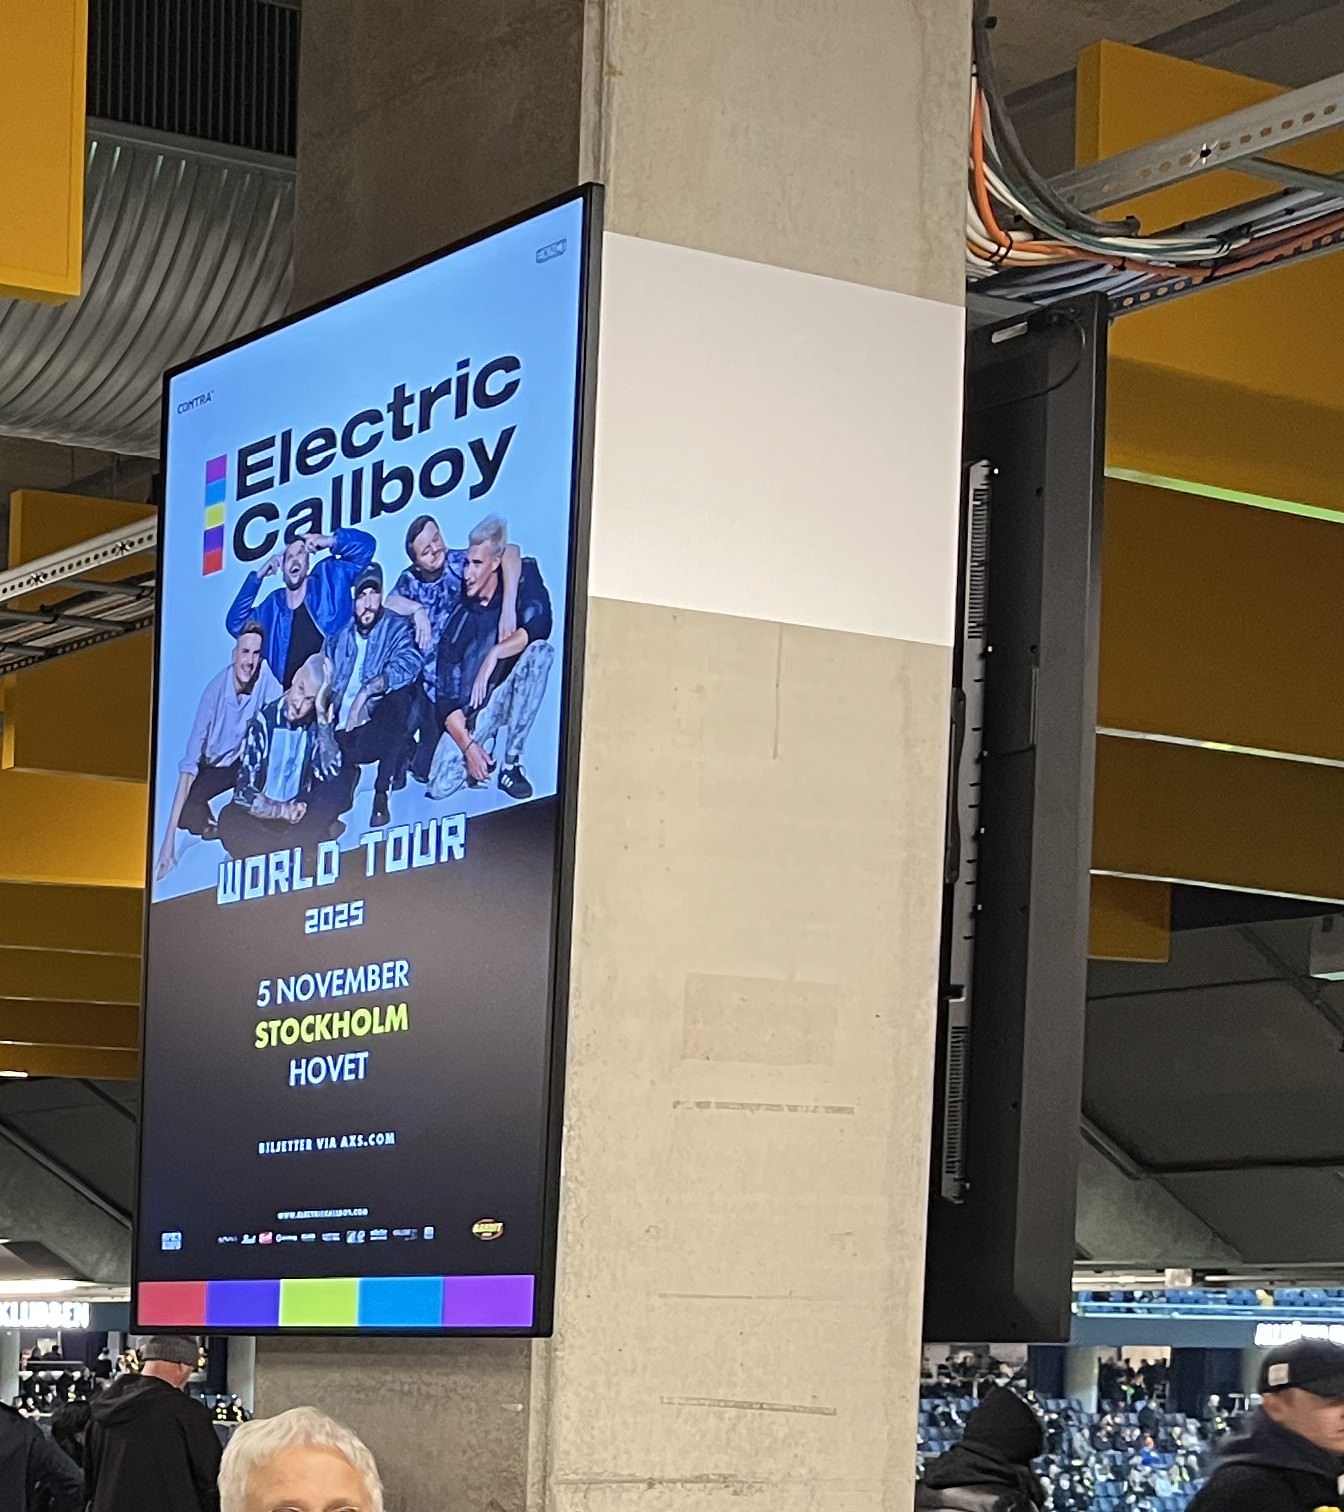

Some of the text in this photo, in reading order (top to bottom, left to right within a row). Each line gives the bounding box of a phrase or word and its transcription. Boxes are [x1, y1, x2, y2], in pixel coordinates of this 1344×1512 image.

[235, 355, 521, 501] Electric
[233, 424, 518, 562] Callboy
[217, 812, 467, 905] WORLD TOUR
[304, 899, 365, 934] 2025
[256, 959, 410, 1007] 5 NOVEMBER
[254, 1002, 409, 1049] STOCKHOLM
[289, 1051, 369, 1087] HOVET
[259, 1132, 396, 1154] BILJETTER VIA AXS.COM
